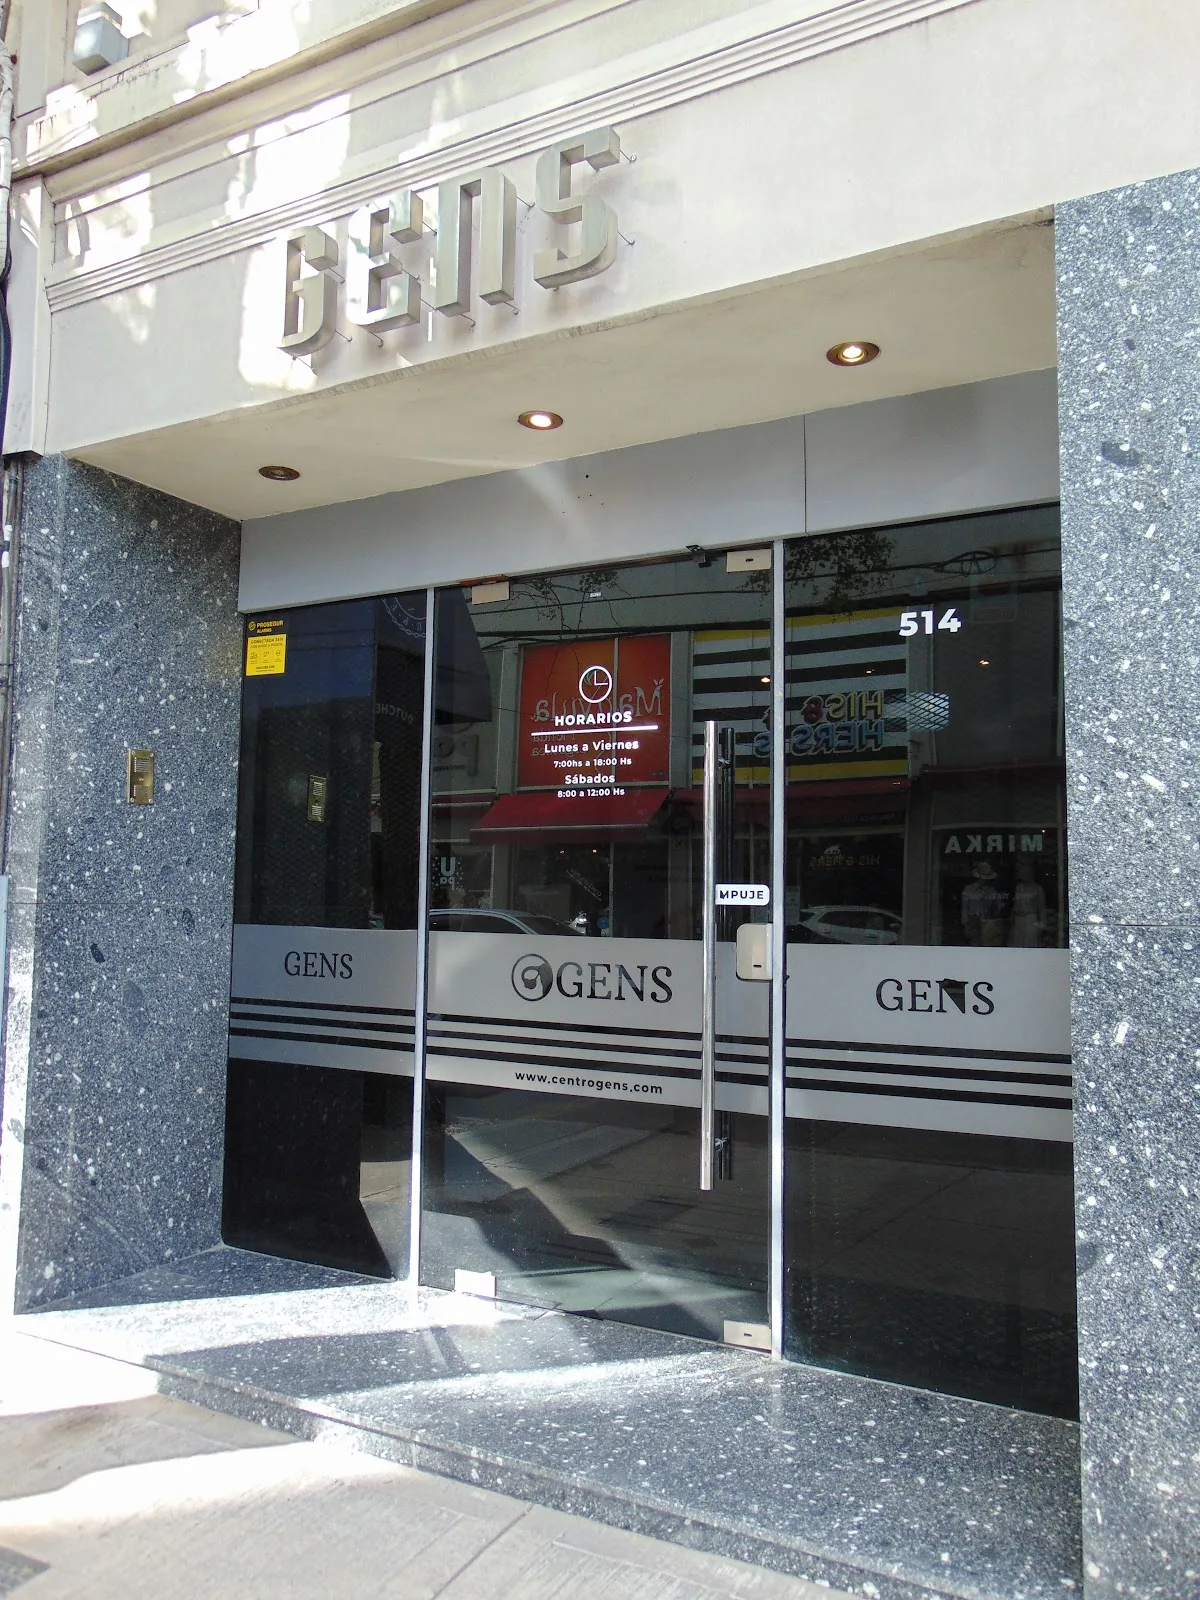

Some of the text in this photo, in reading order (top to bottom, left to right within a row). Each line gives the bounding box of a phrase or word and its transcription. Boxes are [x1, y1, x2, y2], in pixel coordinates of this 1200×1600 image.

[277, 126, 620, 357] GENS
[898, 607, 963, 637] 514
[554, 710, 633, 727] HORARIOS
[544, 743, 579, 754] Lunes
[582, 743, 589, 751] a
[592, 739, 640, 752] Viernes
[553, 757, 633, 769] 7:00hs a 18:00 Hs
[564, 773, 616, 785] Sábados
[557, 789, 577, 798] 8:00
[586, 788, 611, 797] 12:00
[612, 787, 625, 796] Hs
[719, 889, 764, 900] MPUJE
[284, 950, 354, 980] GENS
[555, 961, 674, 1004] GENS
[875, 977, 996, 1016] GENS
[515, 1070, 664, 1097] www.centrogens.com
